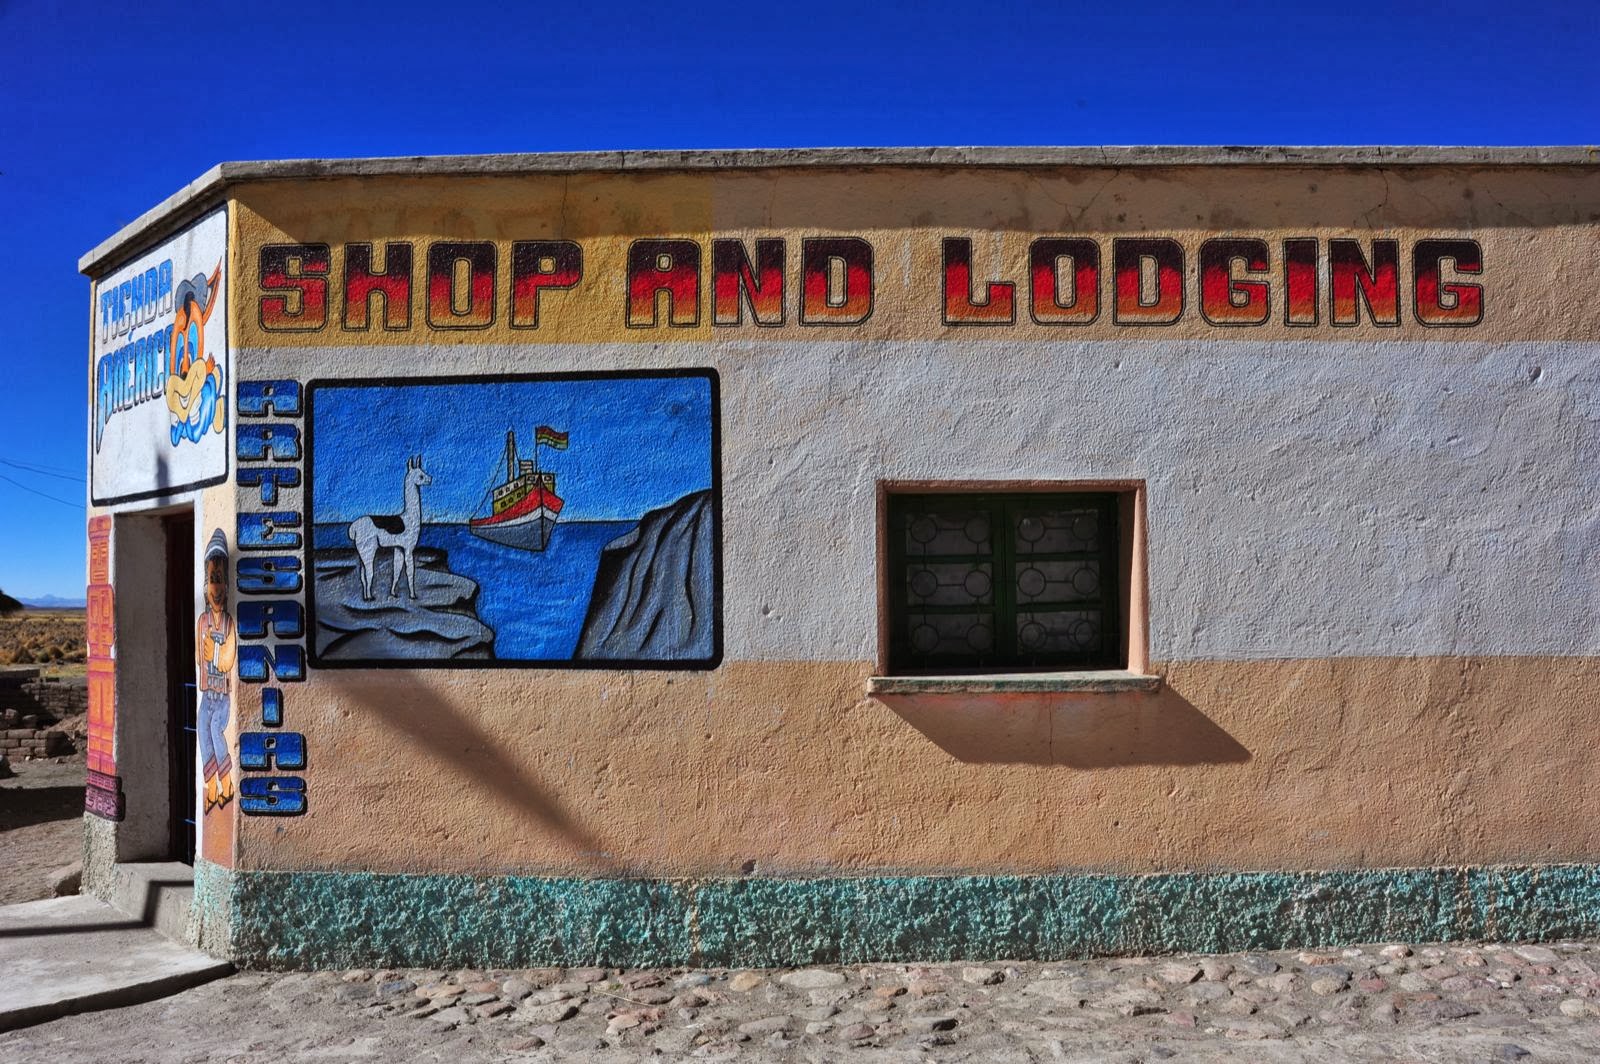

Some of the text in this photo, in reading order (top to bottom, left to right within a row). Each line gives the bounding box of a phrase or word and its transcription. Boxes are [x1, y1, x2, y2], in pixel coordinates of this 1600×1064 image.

[100, 258, 174, 344] TIENDA
[258, 237, 1484, 332] SHOP AND LODGING
[236, 379, 308, 816] ARTESANIAS
